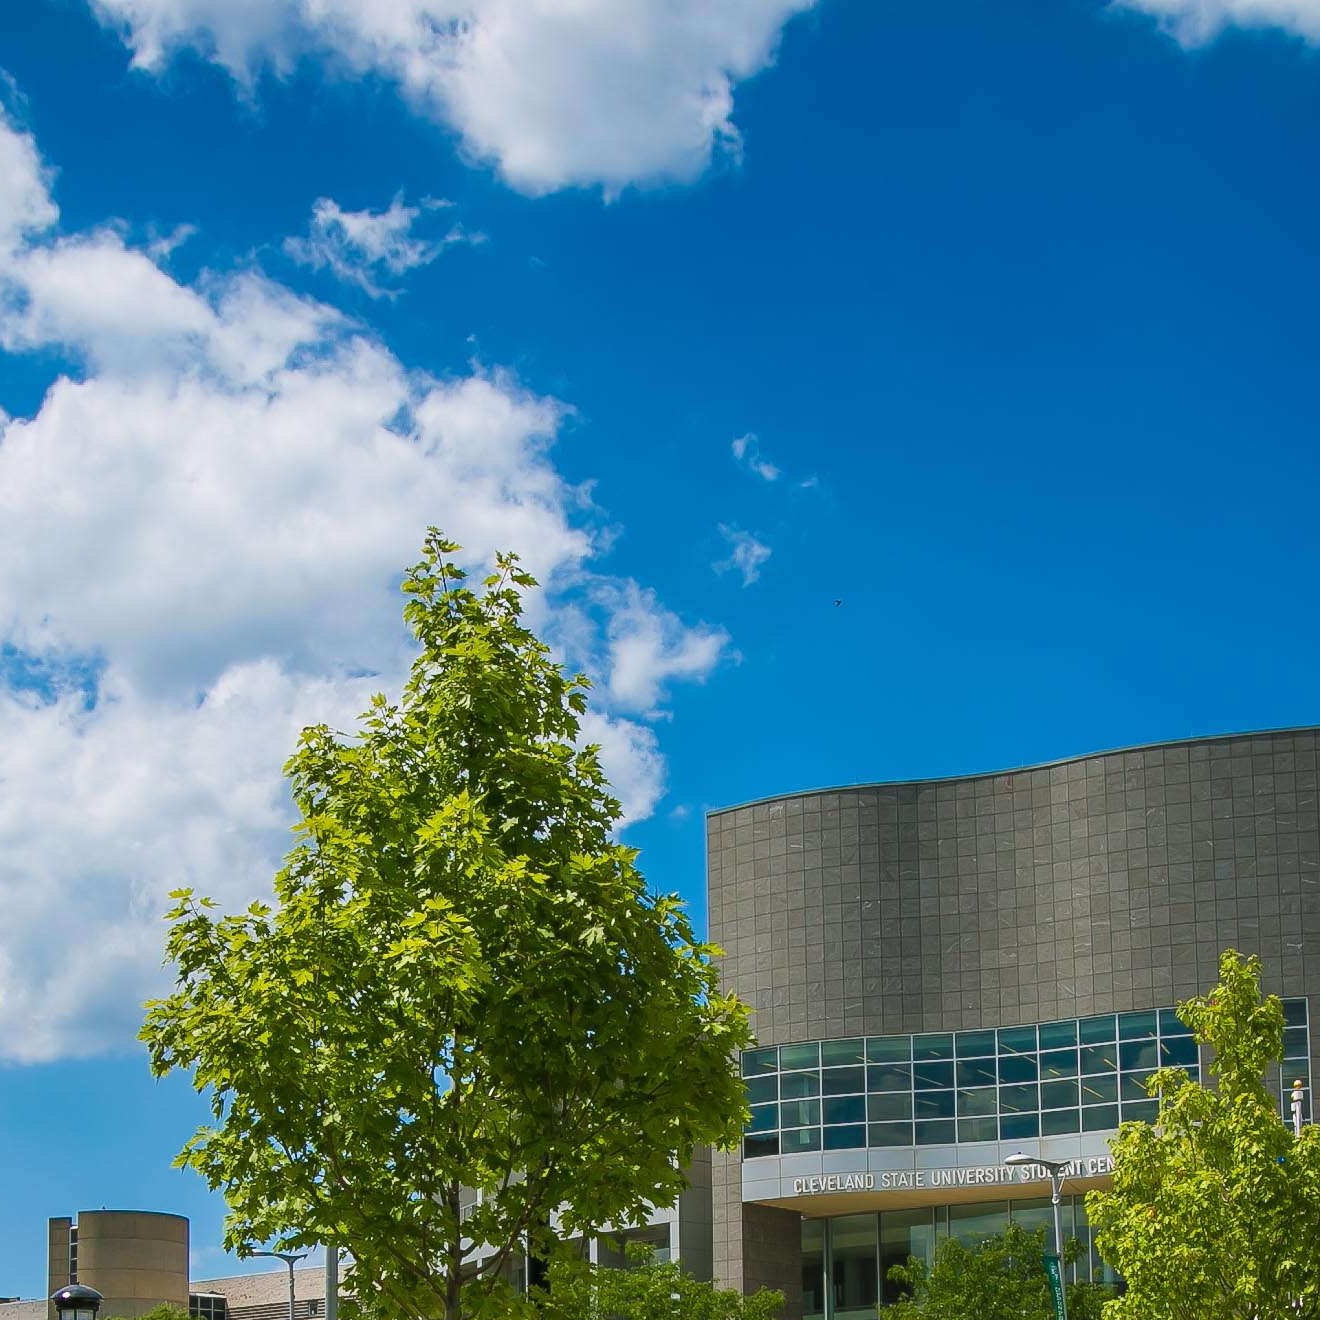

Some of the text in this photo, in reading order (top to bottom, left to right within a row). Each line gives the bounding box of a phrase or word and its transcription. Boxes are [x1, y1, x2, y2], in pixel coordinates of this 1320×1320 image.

[793, 1174, 874, 1193] CLEVELAND
[881, 1171, 924, 1188] STATE
[931, 1165, 1015, 1186] UNIVERSITY
